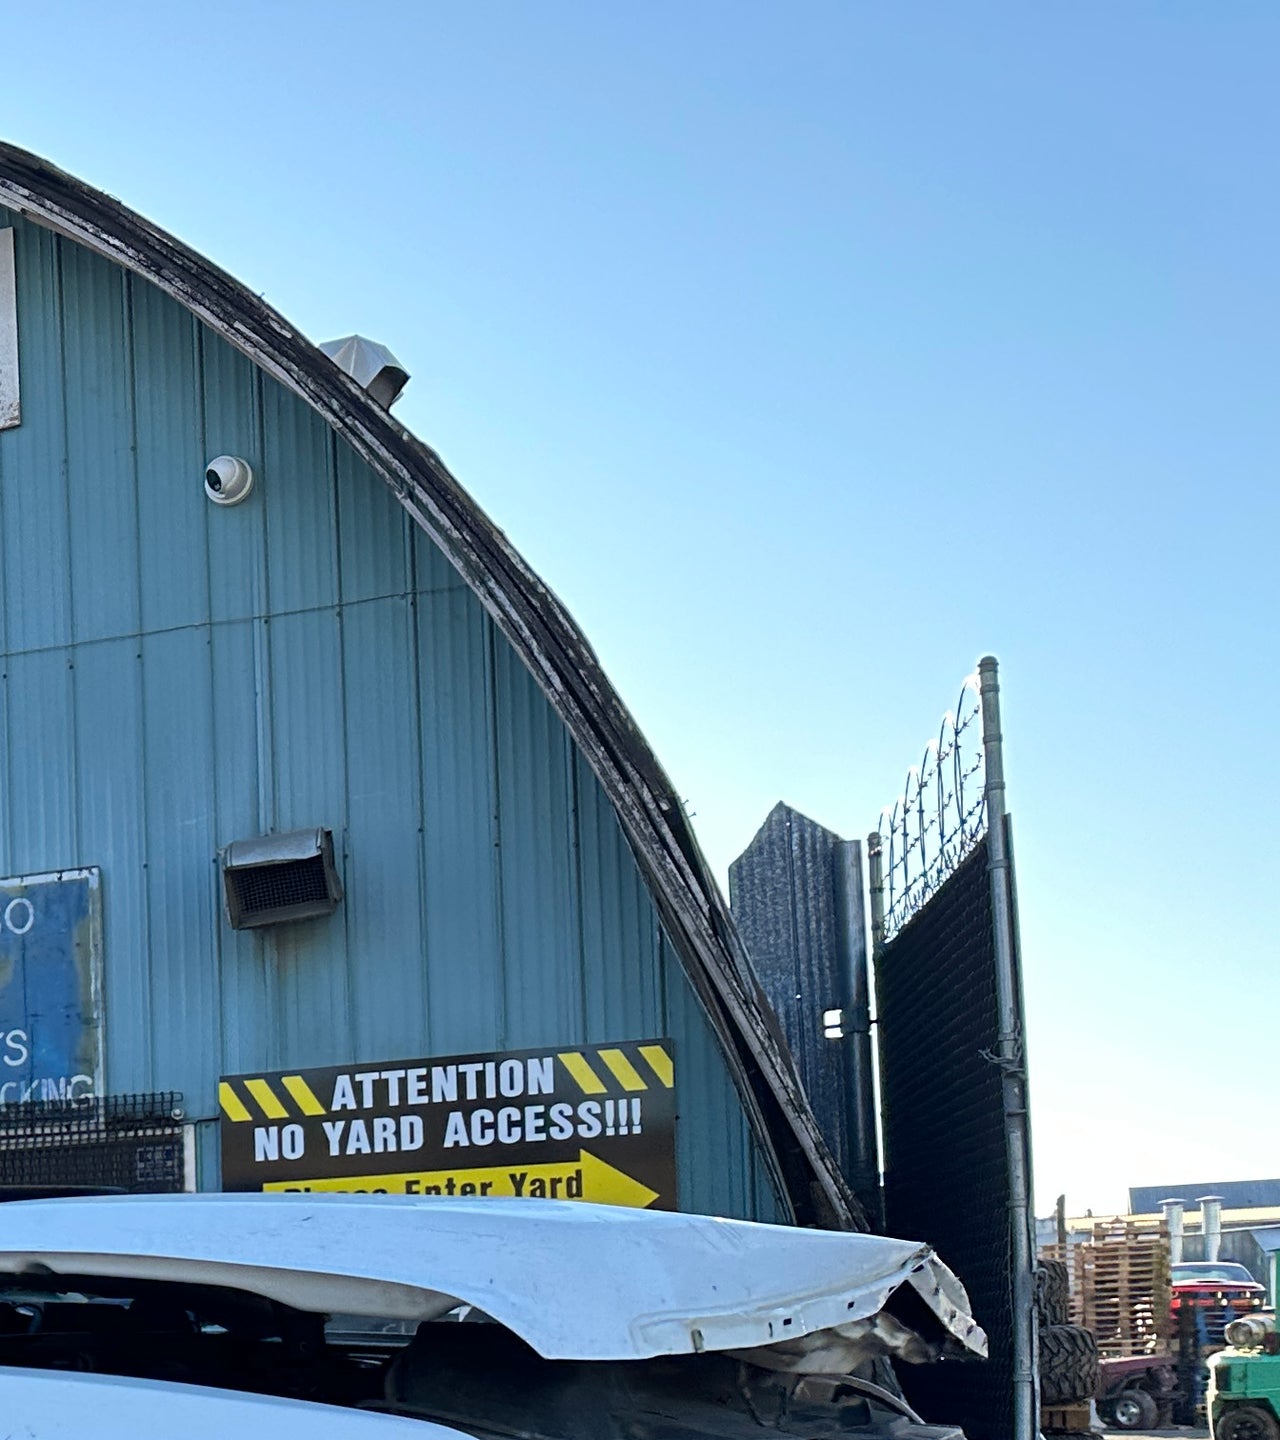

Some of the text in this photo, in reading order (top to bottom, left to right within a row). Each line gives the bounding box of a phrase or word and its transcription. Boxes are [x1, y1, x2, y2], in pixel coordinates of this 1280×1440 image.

[331, 1056, 555, 1112] ATTENTION
[254, 1097, 643, 1162] NO YARD ACCESS!!!
[509, 1169, 583, 1199] Yard
